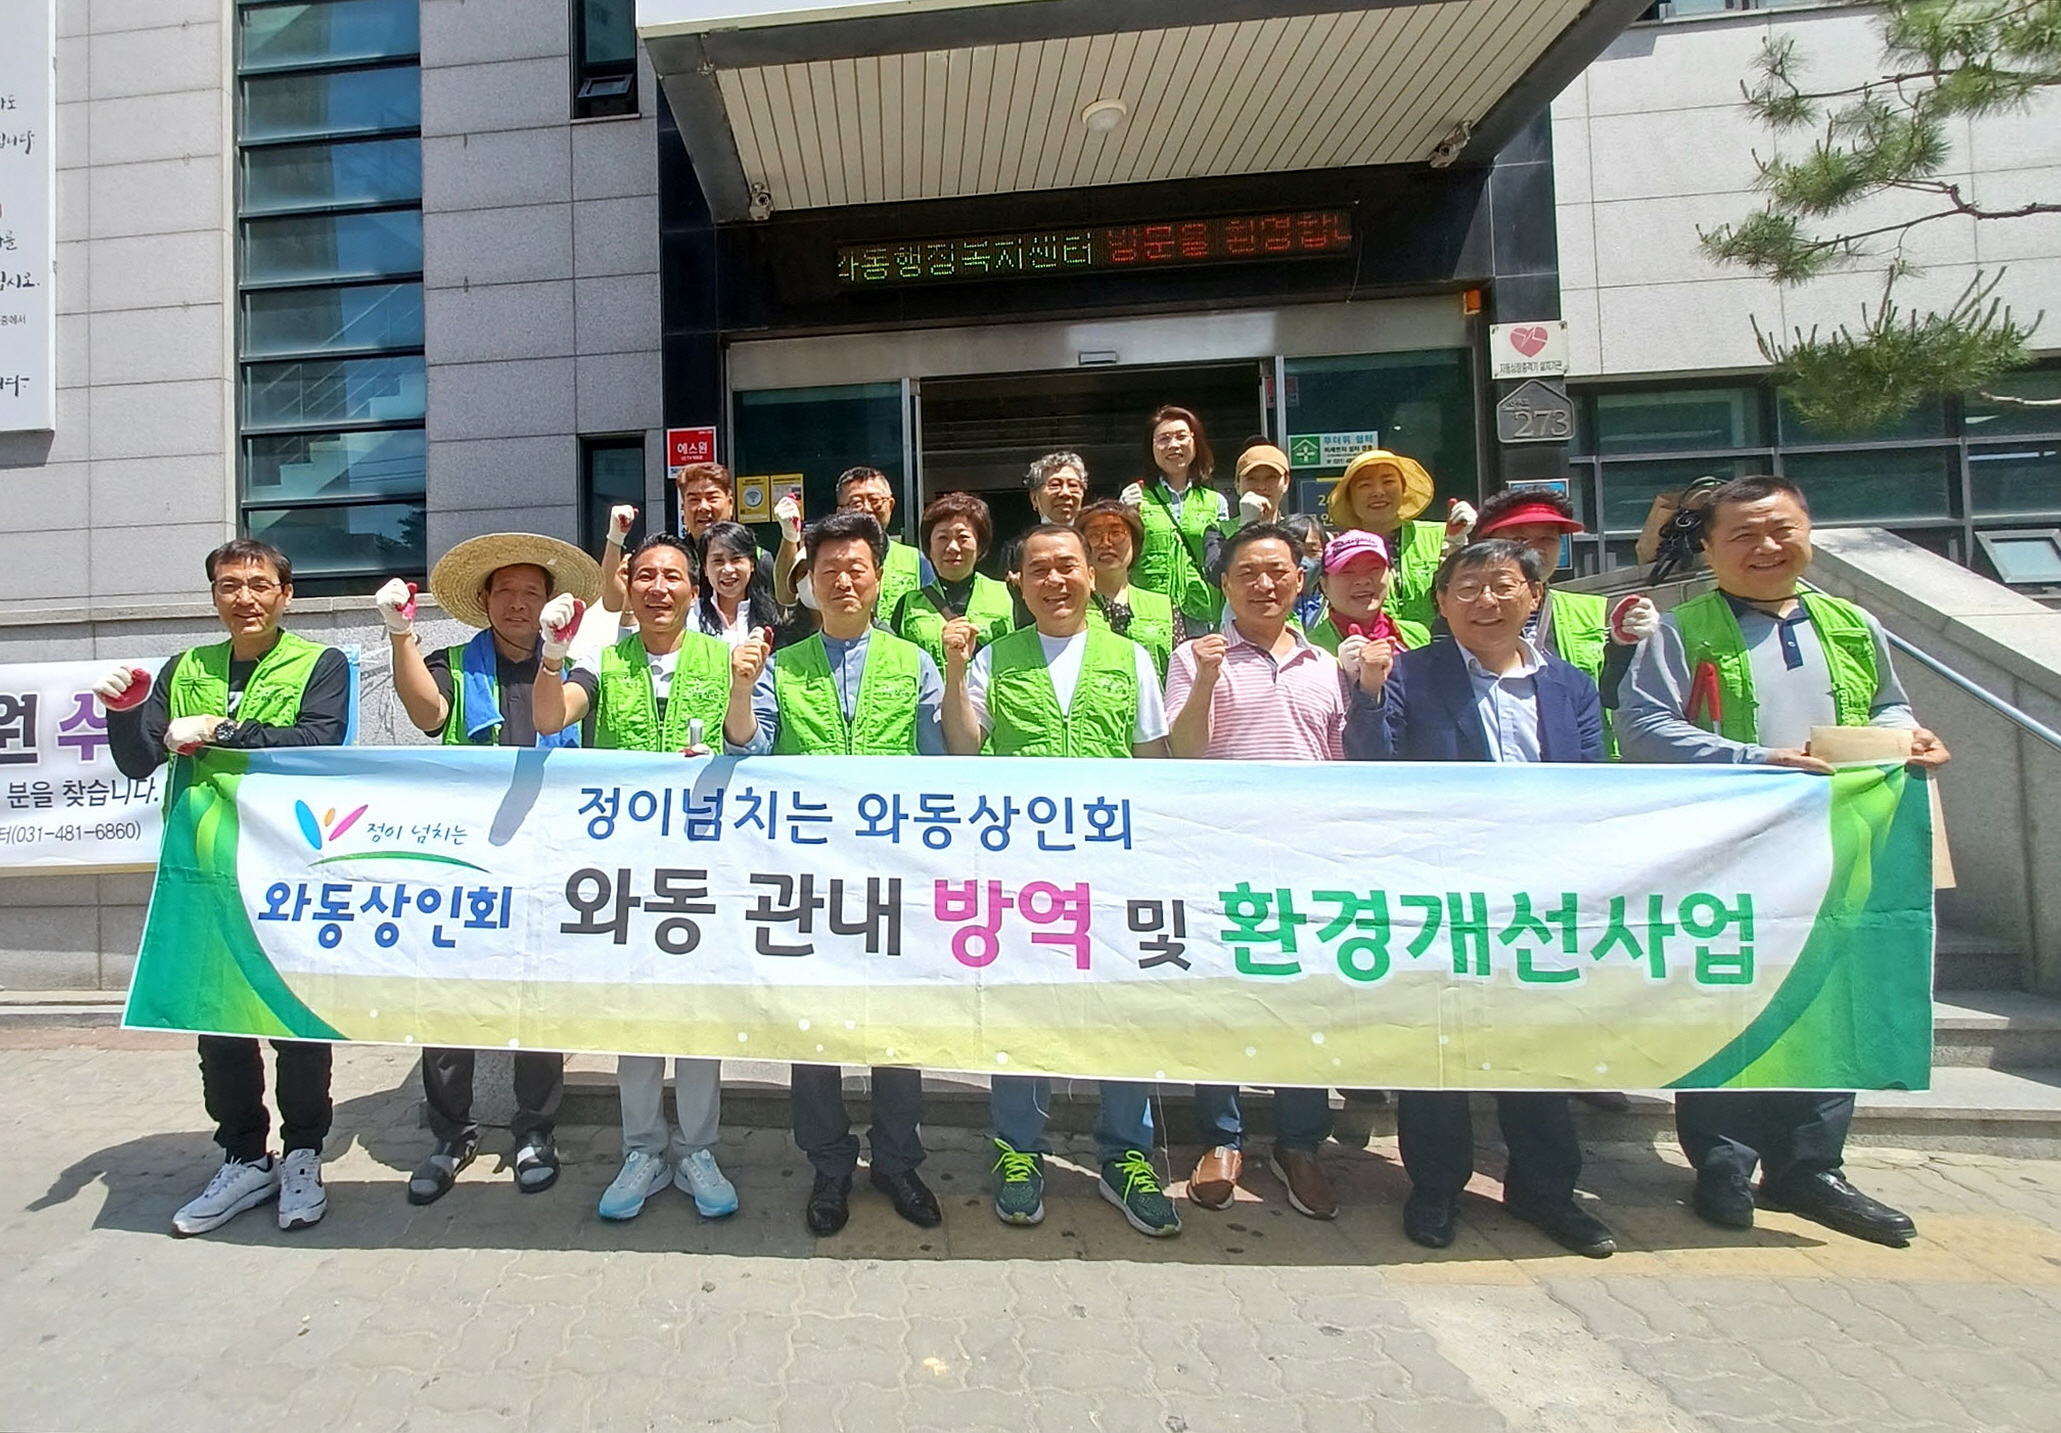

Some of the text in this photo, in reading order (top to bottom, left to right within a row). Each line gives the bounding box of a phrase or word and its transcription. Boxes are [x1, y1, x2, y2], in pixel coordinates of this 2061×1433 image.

[1513, 409, 1568, 438] 273
[677, 441, 707, 455] 에스원
[7, 777, 159, 809] 분을 찾습니다.
[367, 822, 469, 845] 정이 넘치는
[578, 787, 1131, 851] 정이넘치는 와동상인회
[258, 881, 513, 949] 와동상인회
[560, 868, 1755, 985] 와동 관내 방역 및 환경개선사업
